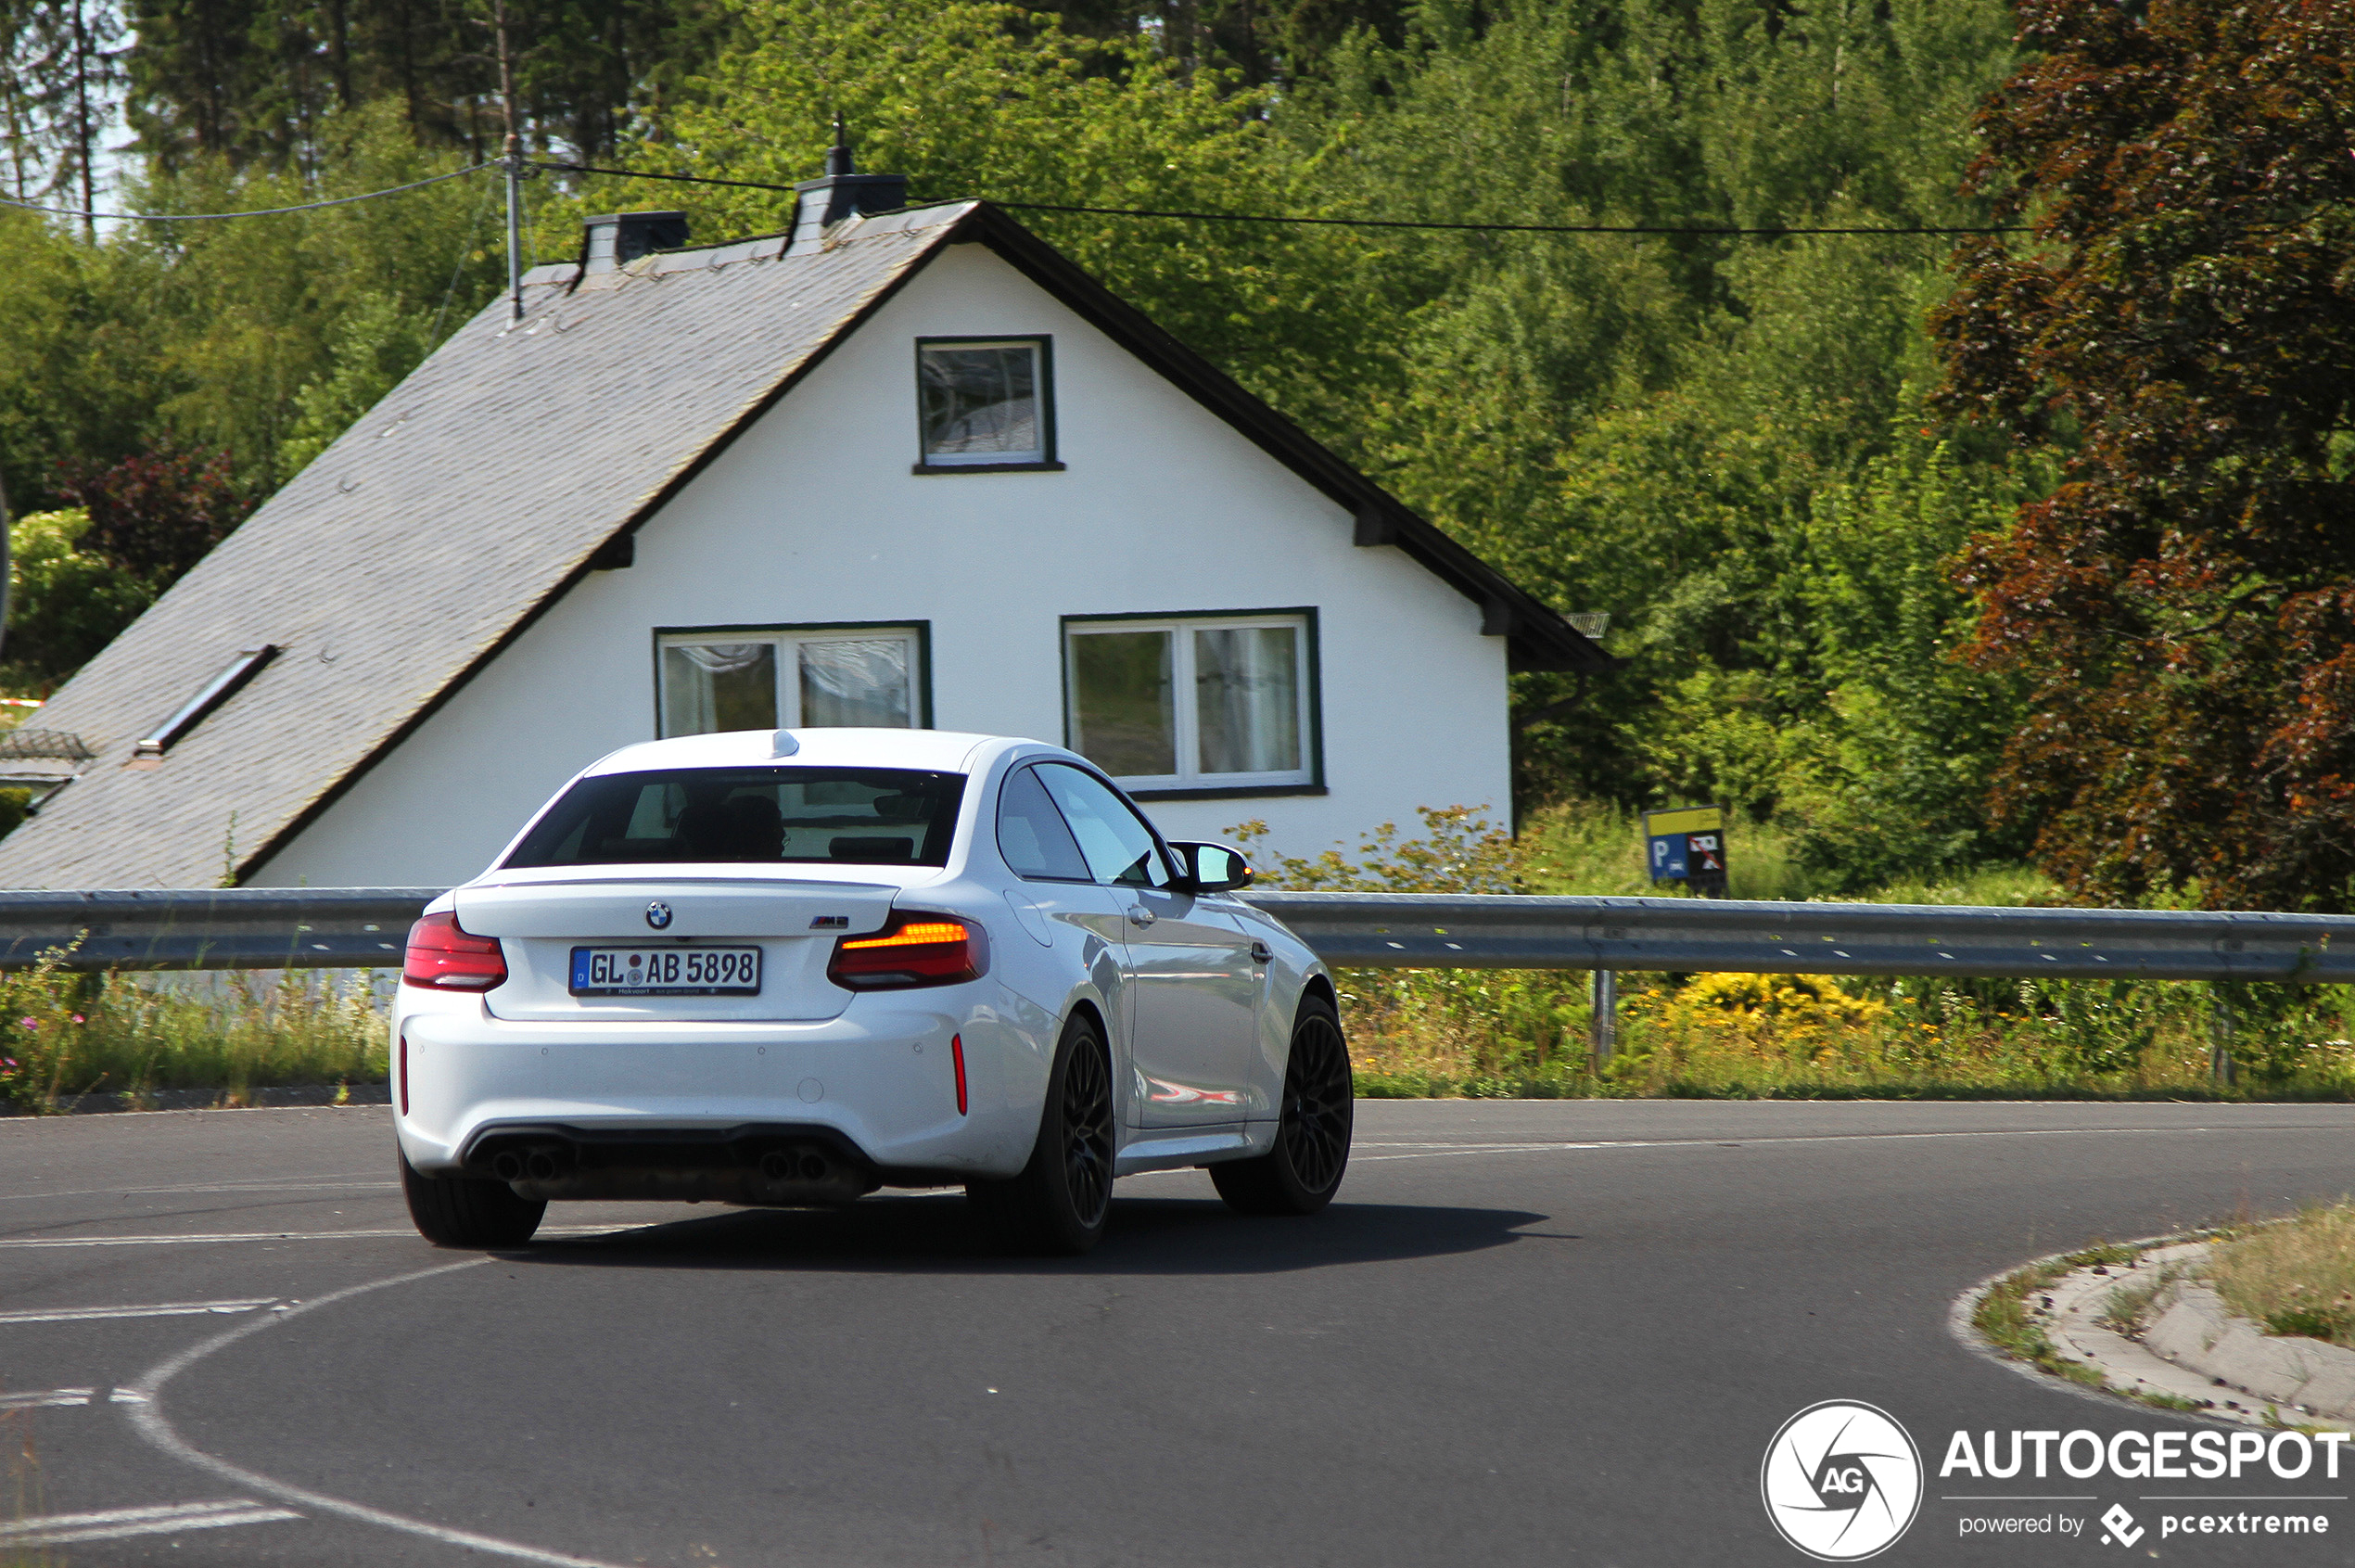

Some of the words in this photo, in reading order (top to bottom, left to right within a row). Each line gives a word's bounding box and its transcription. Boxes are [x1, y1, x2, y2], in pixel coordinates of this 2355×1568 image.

[1652, 840, 1669, 868] P
[578, 973, 584, 982] D
[591, 953, 624, 984] GL
[646, 953, 680, 983] AB
[686, 953, 753, 983] 5898
